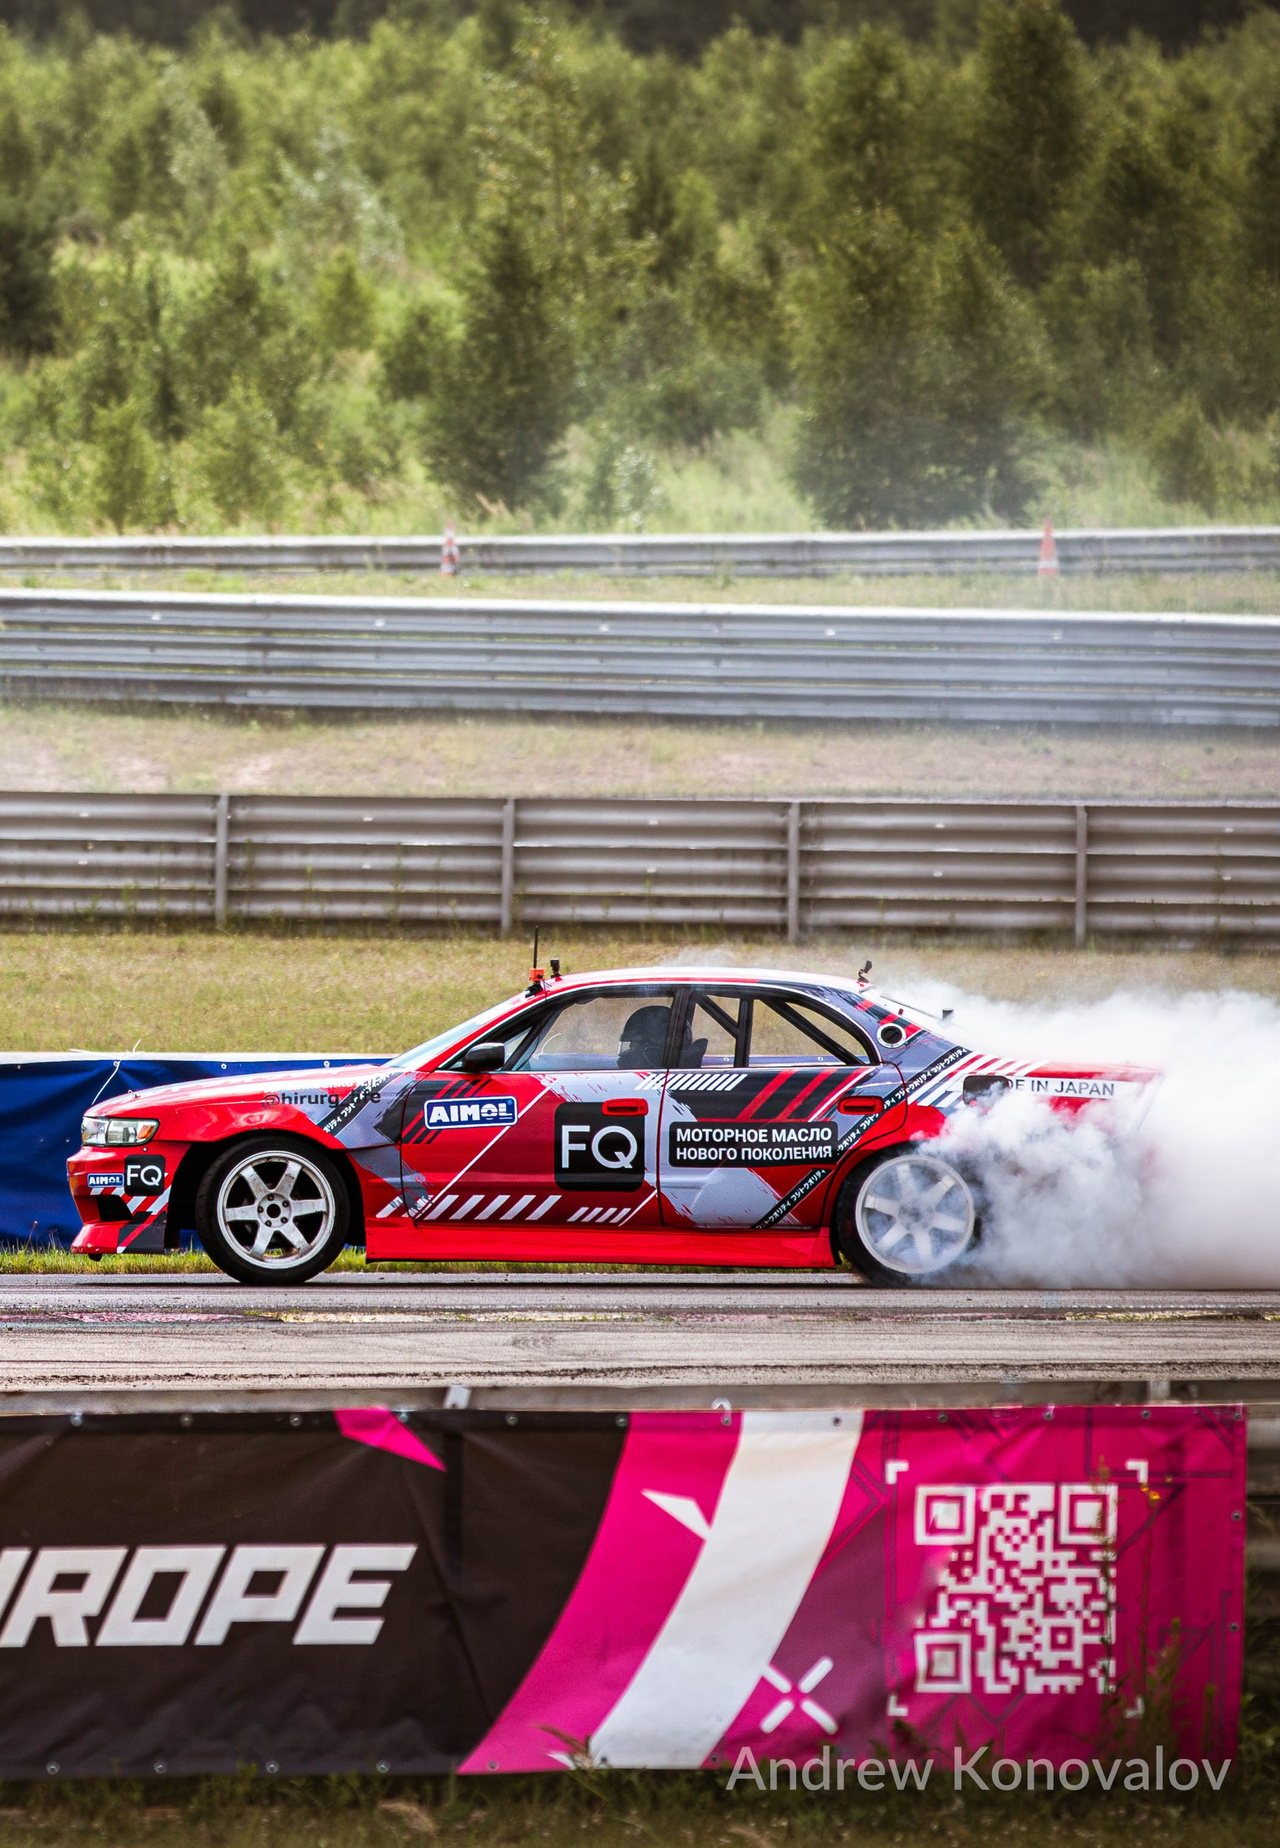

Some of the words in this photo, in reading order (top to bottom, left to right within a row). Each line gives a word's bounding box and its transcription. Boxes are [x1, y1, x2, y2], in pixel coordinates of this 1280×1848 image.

[1031, 1080, 1048, 1092] IN
[1055, 1081, 1114, 1096] JAPAN
[429, 1103, 513, 1123] AIMOL
[676, 1128, 768, 1143] МОТОРНОЕ
[772, 1127, 832, 1143] МАСЛО
[561, 1125, 638, 1169] FQ
[676, 1147, 738, 1160] НОВОГО
[741, 1145, 832, 1161] ПОКОЛЕНИЯ
[89, 1176, 122, 1185] AIMOL
[126, 1165, 163, 1186] FQ
